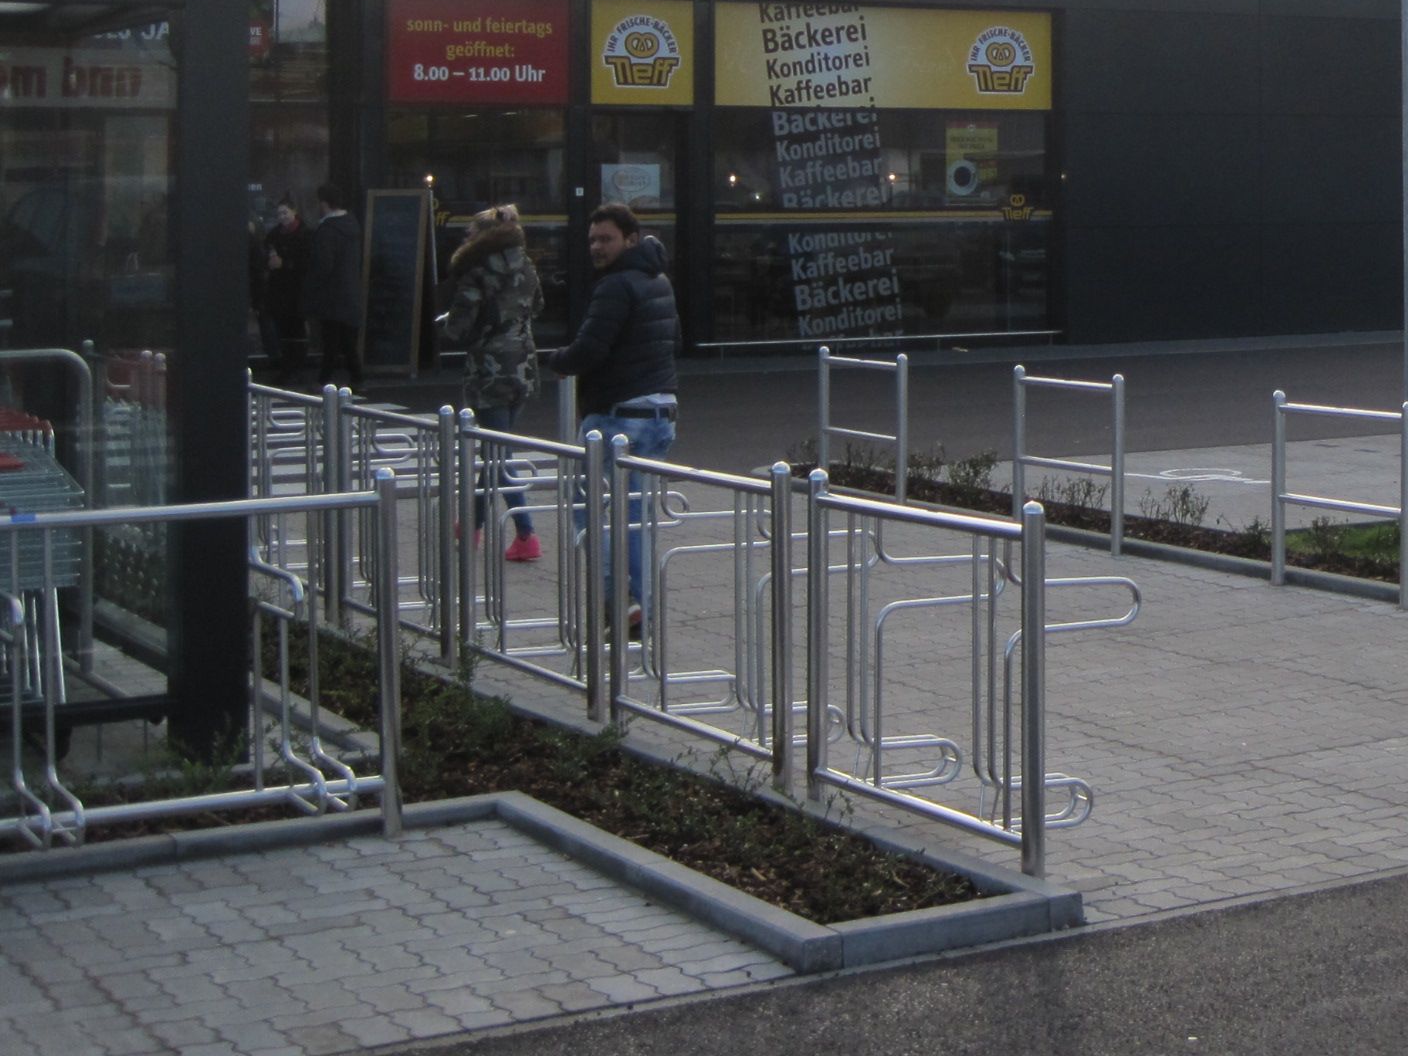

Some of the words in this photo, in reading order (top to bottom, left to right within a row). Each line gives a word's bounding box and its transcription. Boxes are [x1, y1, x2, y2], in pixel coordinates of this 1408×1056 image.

[406, 19, 449, 32] sonn-
[453, 17, 482, 32] und
[486, 17, 553, 37] feiertags
[762, 15, 867, 53] Bäckerei
[445, 41, 515, 60] geöffnet:
[766, 45, 870, 80] Konditorei
[414, 63, 449, 81] 8.00
[468, 67, 511, 81] 11.00
[515, 64, 547, 82] Uhr
[769, 75, 872, 106] Kaffeebar
[776, 126, 881, 162] Konditorei
[780, 156, 882, 188] Kaffeebar
[791, 247, 894, 282] Kaffeebar
[794, 268, 899, 312] Bäckerei
[798, 298, 903, 337] Konditorei
